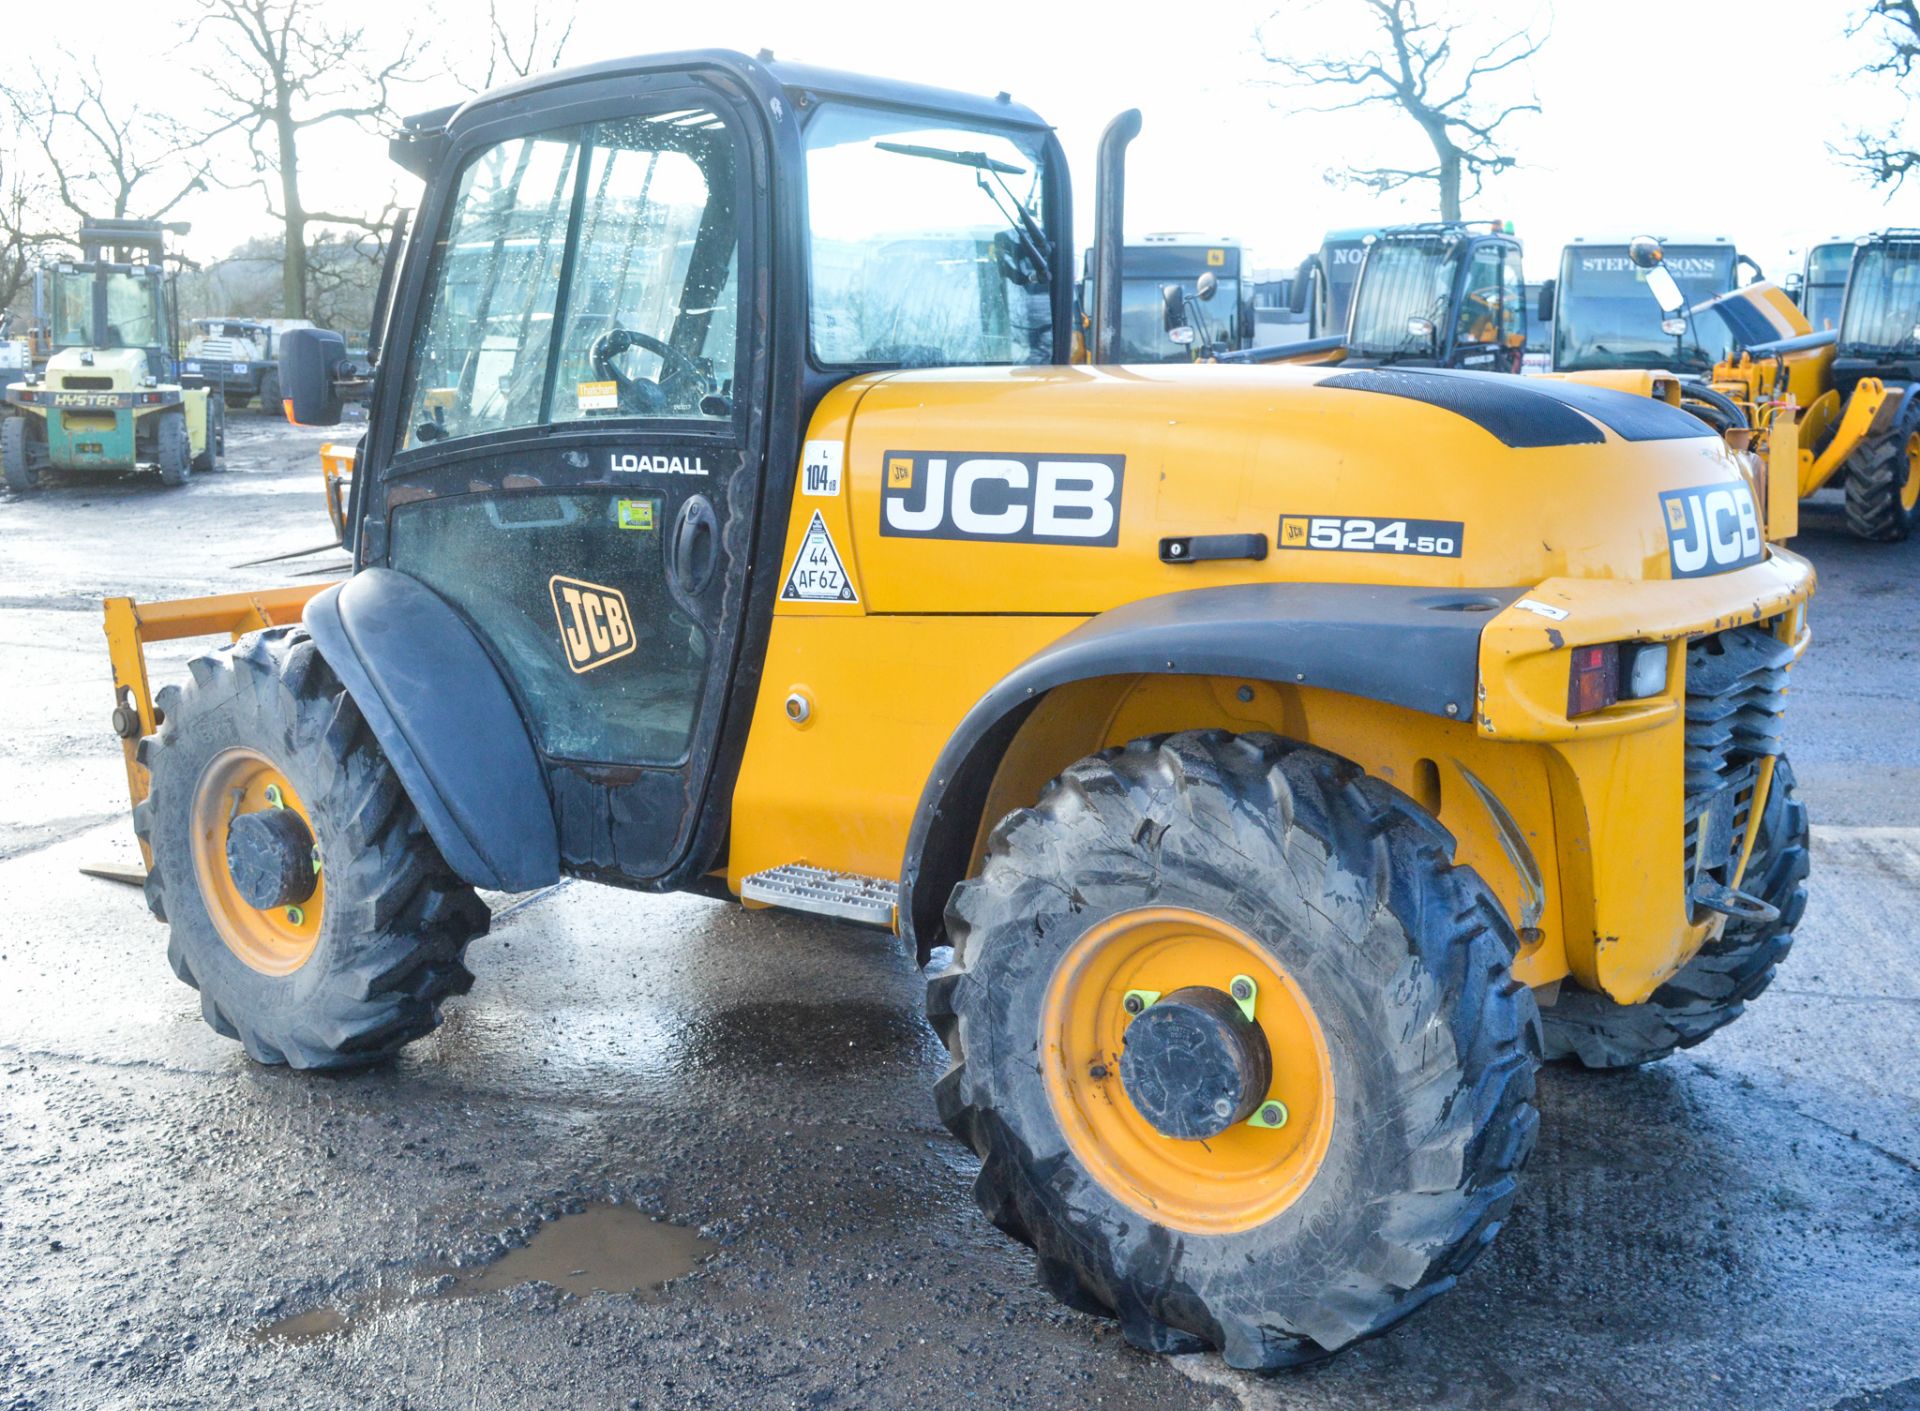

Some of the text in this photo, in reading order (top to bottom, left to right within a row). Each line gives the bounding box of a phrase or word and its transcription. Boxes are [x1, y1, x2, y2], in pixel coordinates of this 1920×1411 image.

[54, 393, 119, 406] HYSTER
[611, 454, 709, 475] LOADALL
[806, 464, 829, 490] 104
[886, 459, 1115, 538] JCB
[1672, 487, 1761, 572] JCB
[809, 547, 828, 566] 44
[799, 570, 838, 589] AF6Z
[562, 586, 629, 662] JCB
